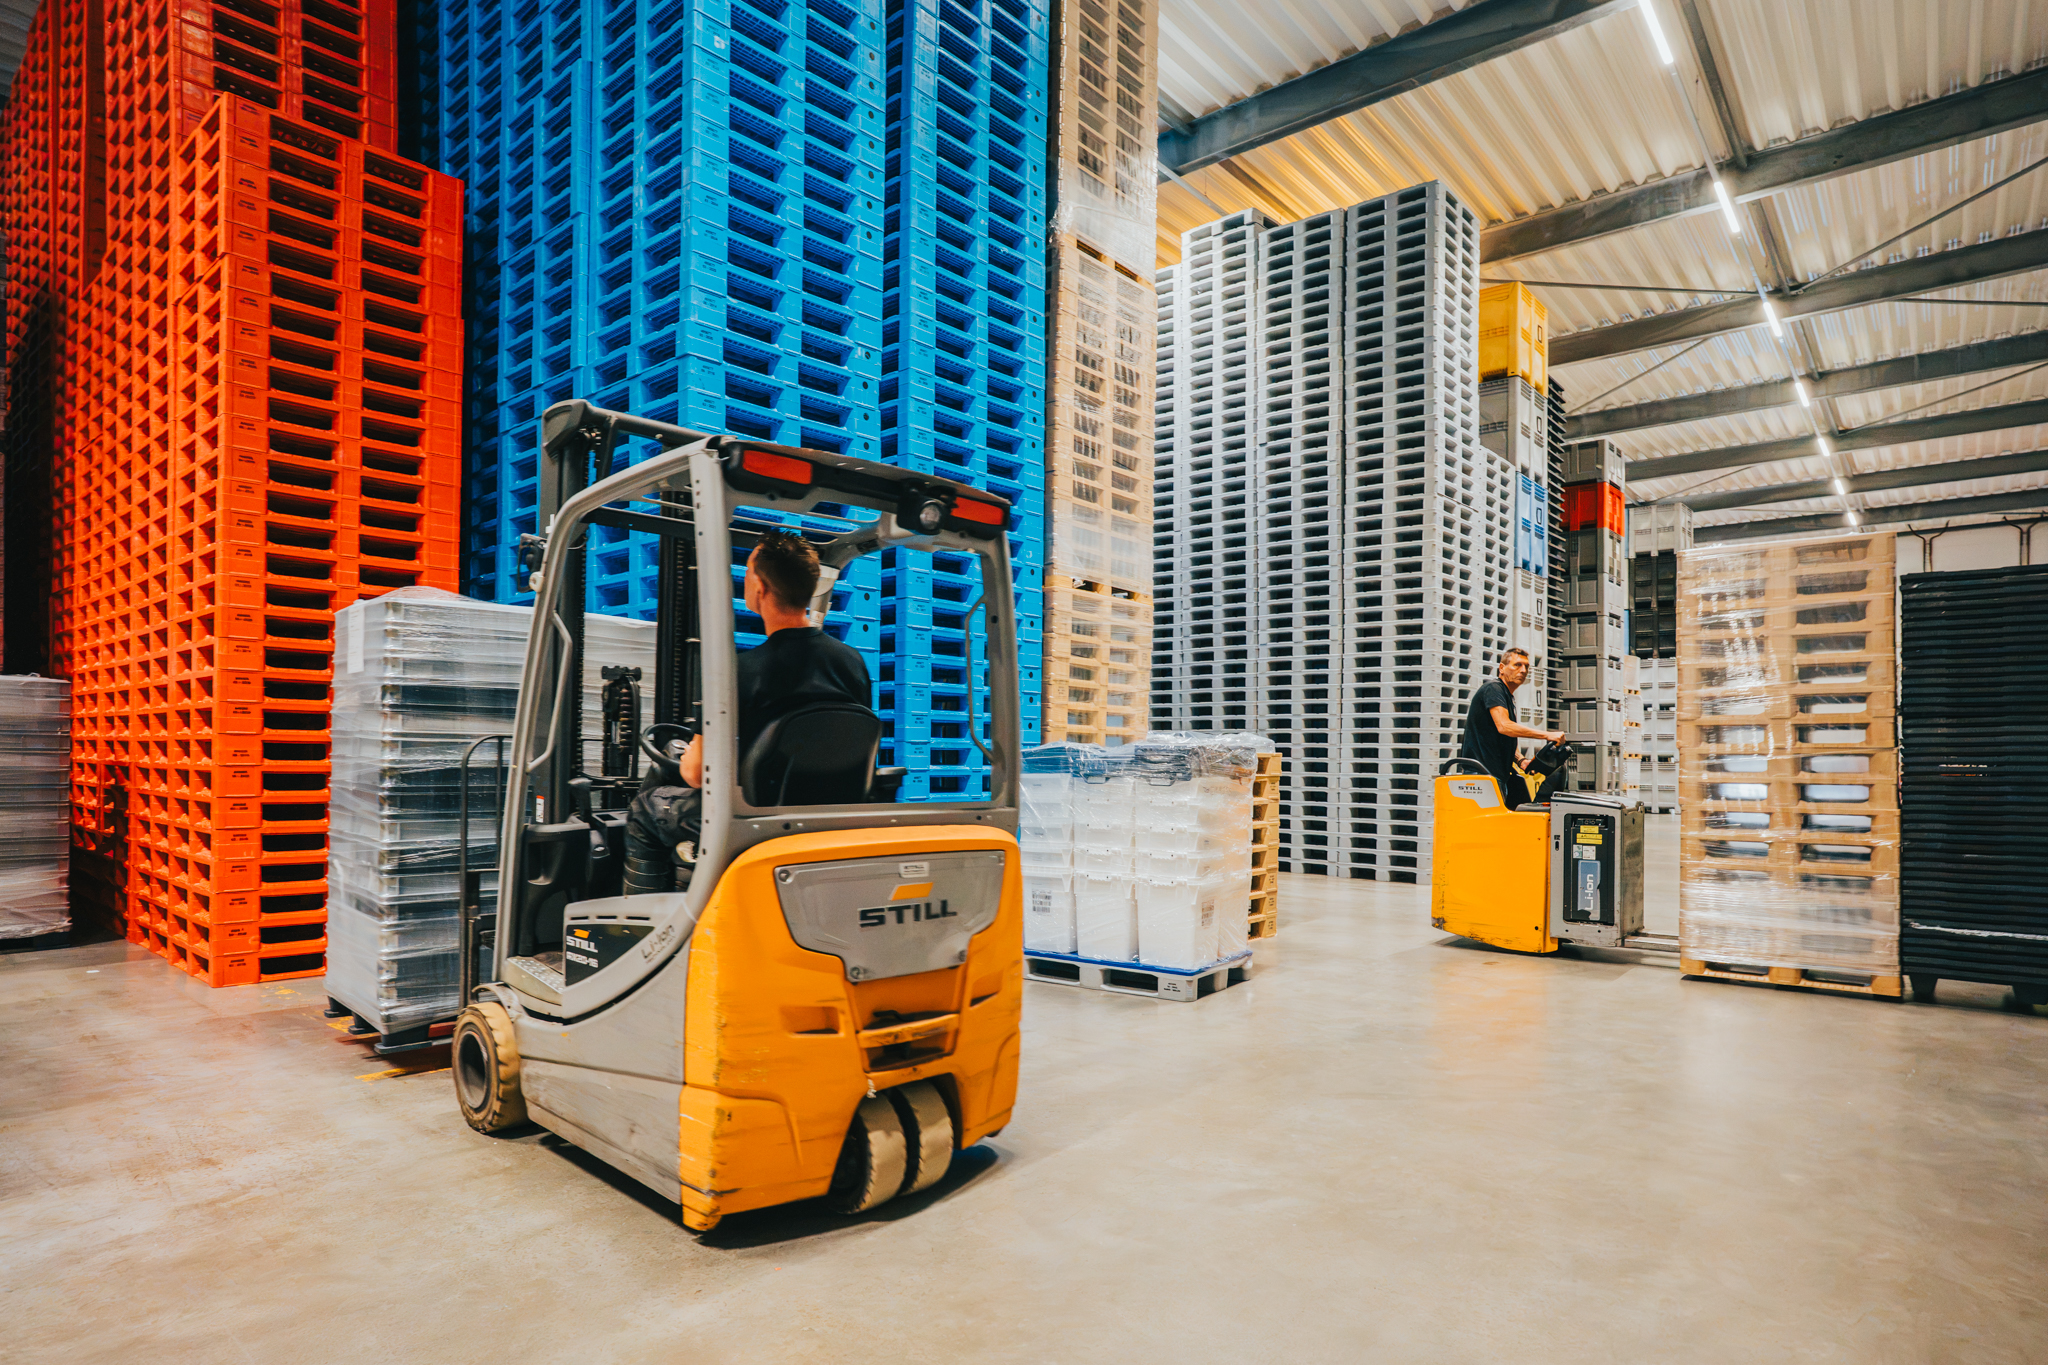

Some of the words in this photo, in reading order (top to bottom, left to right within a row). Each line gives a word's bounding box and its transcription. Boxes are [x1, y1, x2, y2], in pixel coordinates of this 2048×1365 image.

[1585, 874, 1594, 910] Li-Ion
[859, 899, 957, 928] STILL
[566, 935, 599, 953] STILL
